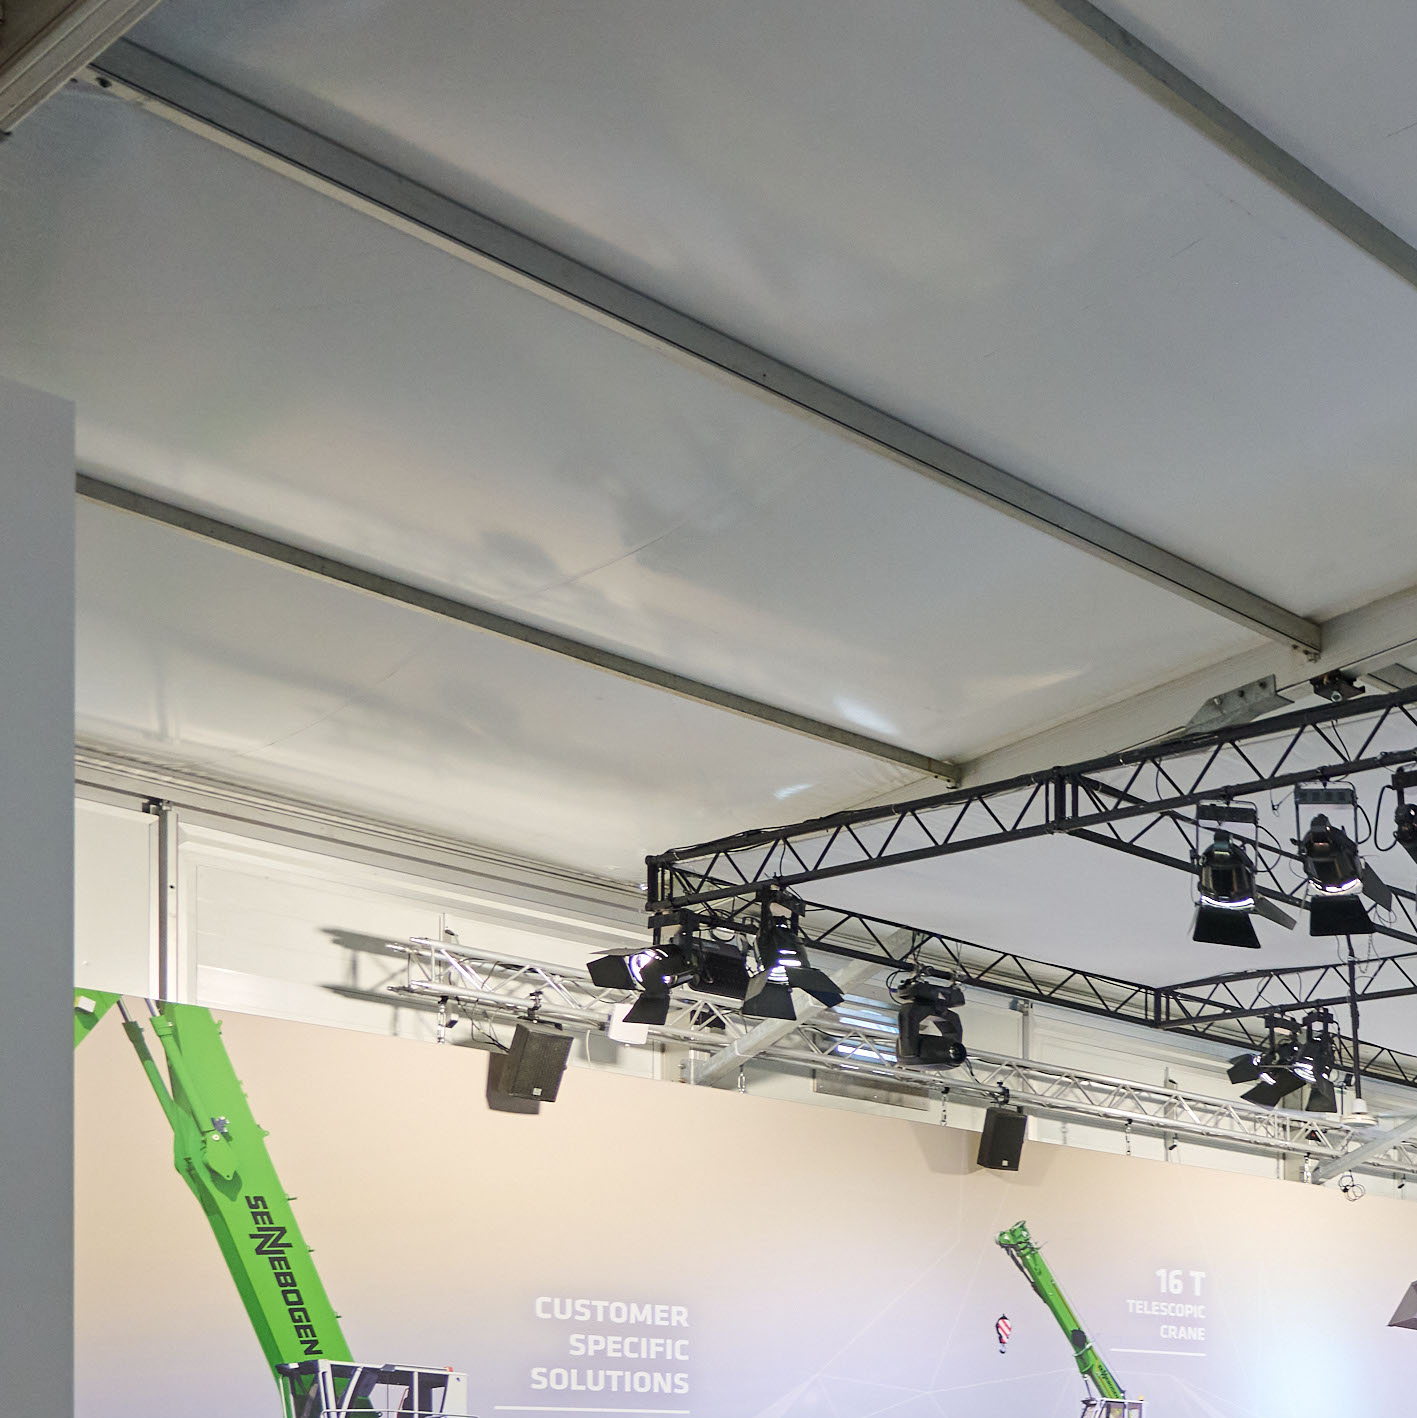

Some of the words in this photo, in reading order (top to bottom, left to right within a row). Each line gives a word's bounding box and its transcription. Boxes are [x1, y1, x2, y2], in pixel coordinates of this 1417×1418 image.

[245, 1195, 323, 1355] SENNEBOGEN
[1155, 1268, 1183, 1294] 16
[1189, 1270, 1206, 1296] T
[535, 1296, 690, 1327] CUSTOMER
[1126, 1299, 1206, 1319] TELESCOPIC
[569, 1333, 690, 1360] SPECIFIC
[1160, 1325, 1205, 1341] CRANE
[530, 1367, 689, 1394] SOLUTIONS
